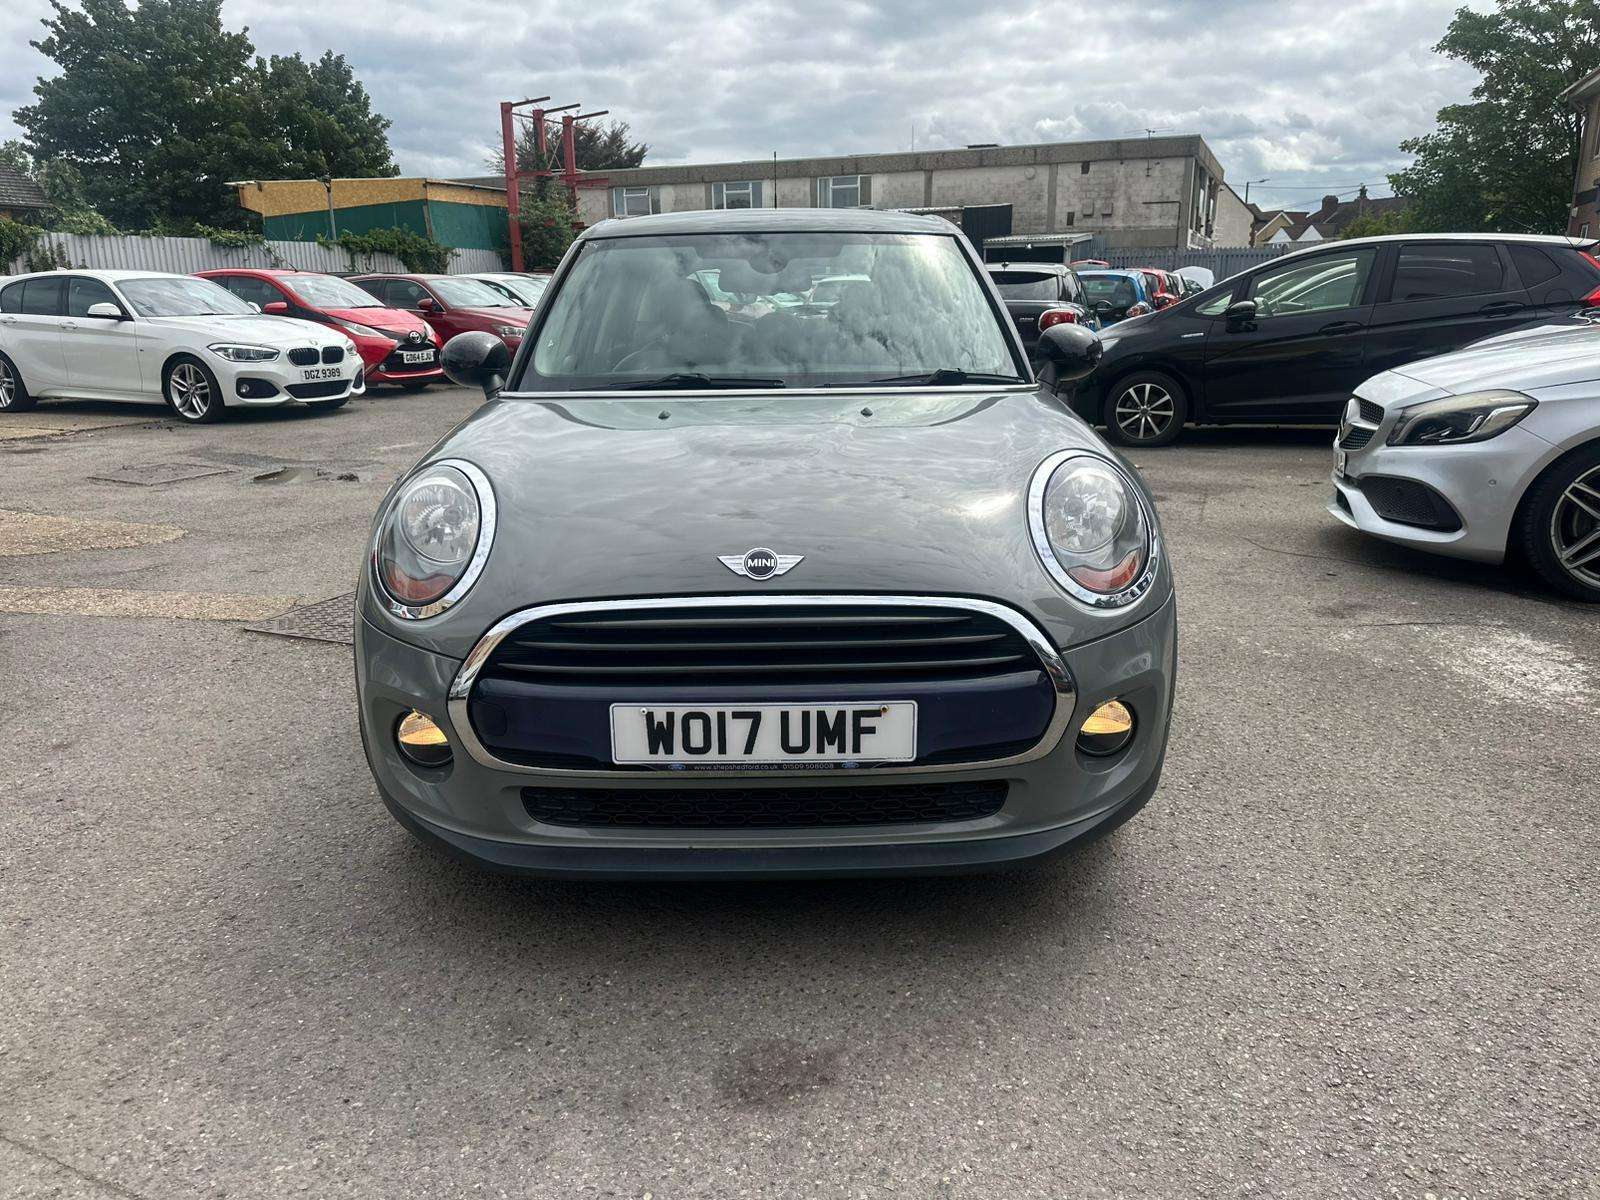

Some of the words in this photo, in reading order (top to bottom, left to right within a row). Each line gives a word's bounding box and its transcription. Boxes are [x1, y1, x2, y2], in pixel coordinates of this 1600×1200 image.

[304, 369, 320, 379] DGZ
[321, 367, 341, 378] 9389
[747, 558, 775, 567] MINI
[645, 710, 762, 755] WO17
[780, 709, 883, 755] UMF
